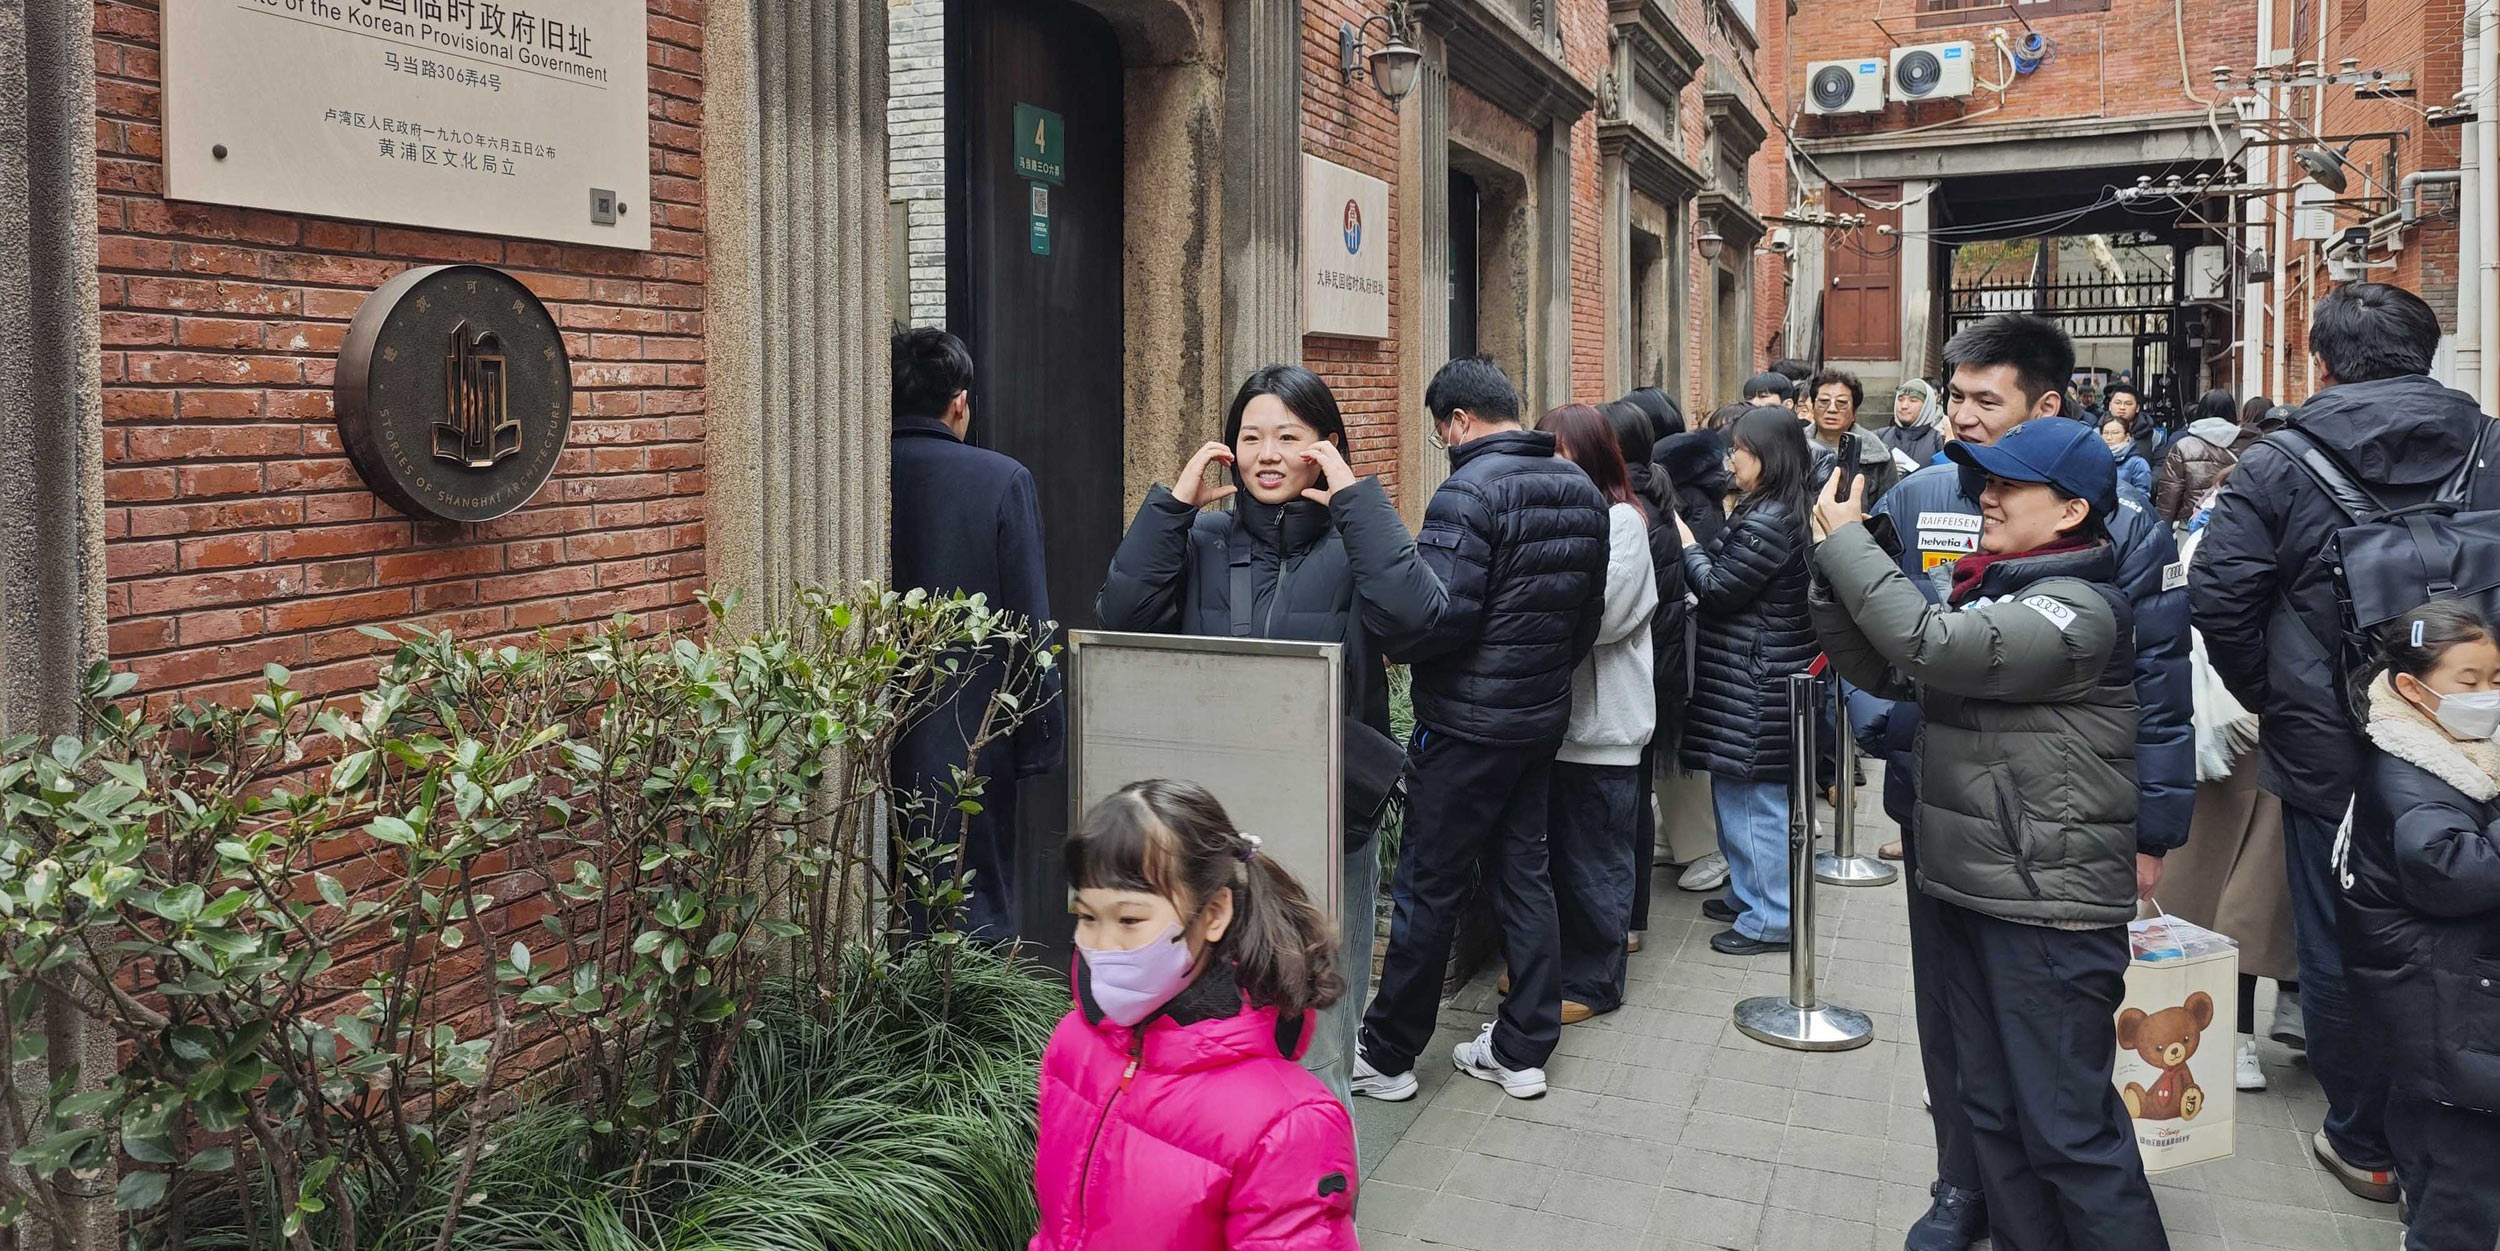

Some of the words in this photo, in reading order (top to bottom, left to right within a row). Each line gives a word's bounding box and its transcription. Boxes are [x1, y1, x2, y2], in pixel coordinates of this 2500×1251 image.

[311, 0, 341, 20] the
[348, 6, 414, 37] Korean
[421, 24, 514, 61] Provisional
[518, 47, 608, 82] Government
[384, 51, 502, 92] 马当路306弄4号
[1034, 118, 1046, 154] 4
[378, 137, 517, 176] 黄浦区文化局立
[380, 408, 414, 475] STORIES
[416, 477, 433, 493] OF
[438, 490, 501, 508] SHANGHAI
[506, 401, 561, 498] ARCHITECTURE
[1920, 516, 1979, 528] RAIFFEISEN
[1921, 536, 1961, 548] helvetia
[2154, 1127, 2181, 1138] Disney
